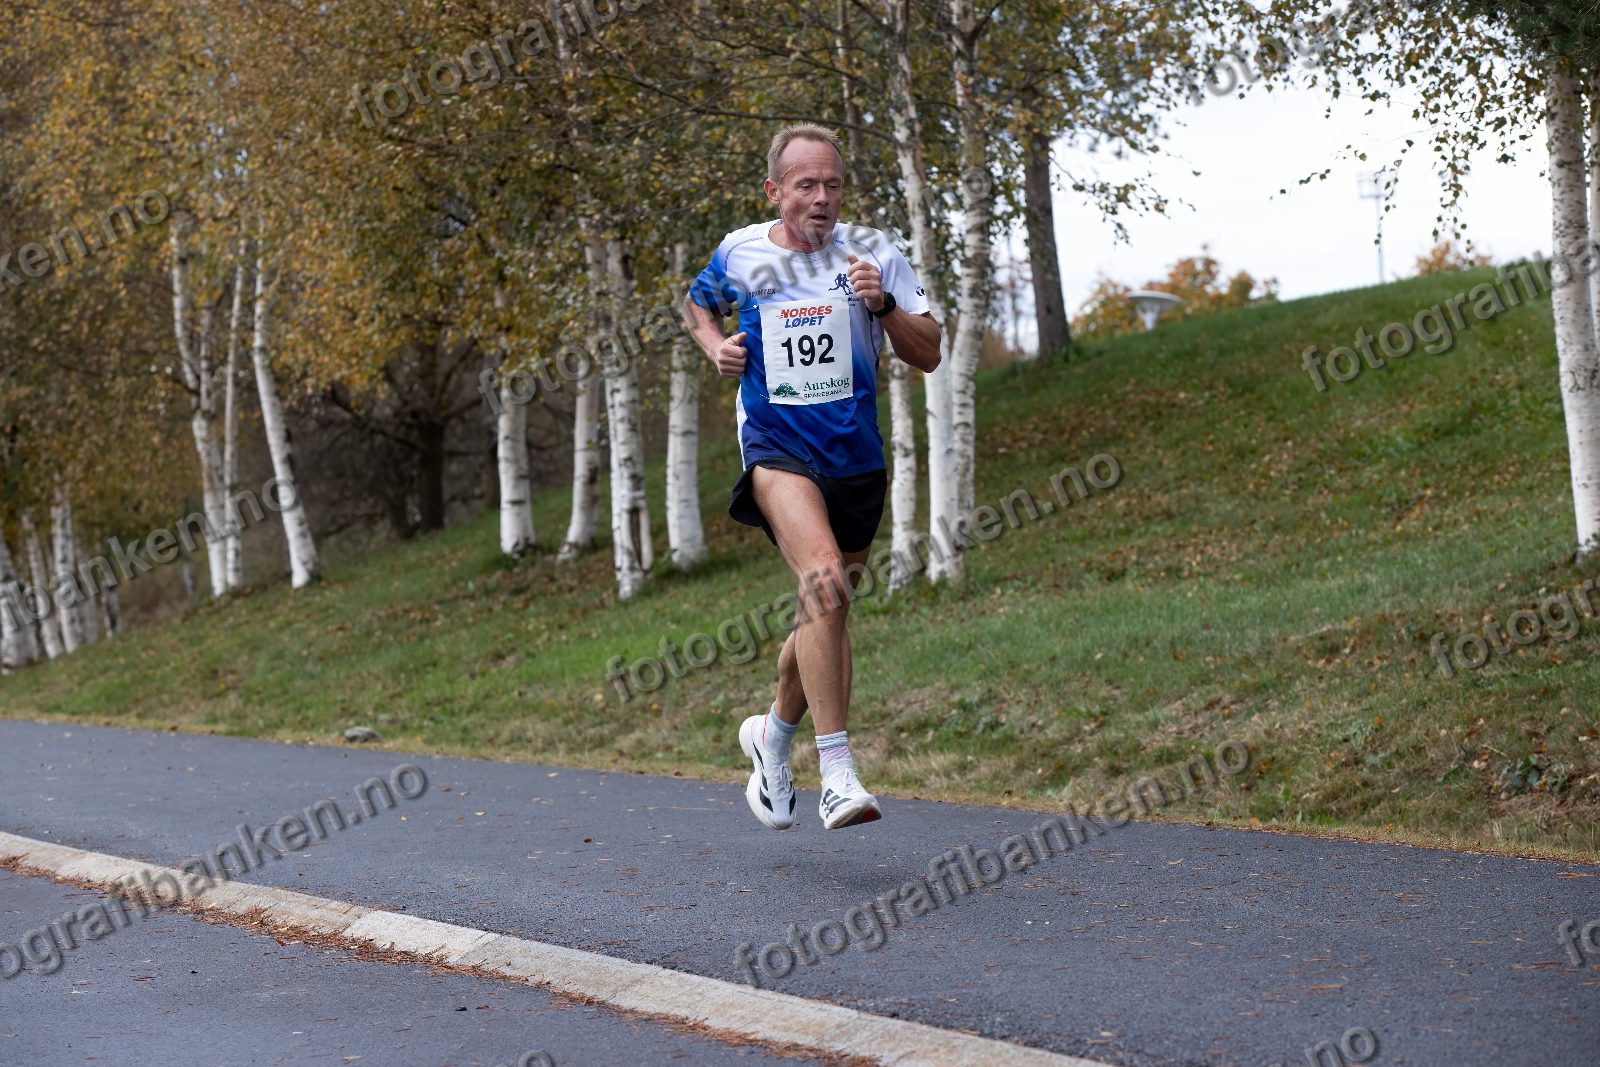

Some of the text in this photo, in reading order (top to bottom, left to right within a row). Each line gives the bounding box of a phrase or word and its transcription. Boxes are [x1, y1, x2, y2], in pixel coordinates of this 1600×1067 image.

[750, 288, 776, 298] RIMTEX
[779, 305, 833, 319] NORGES
[784, 315, 825, 329] LØPET
[781, 333, 835, 368] 192
[803, 377, 850, 391] Aurskog
